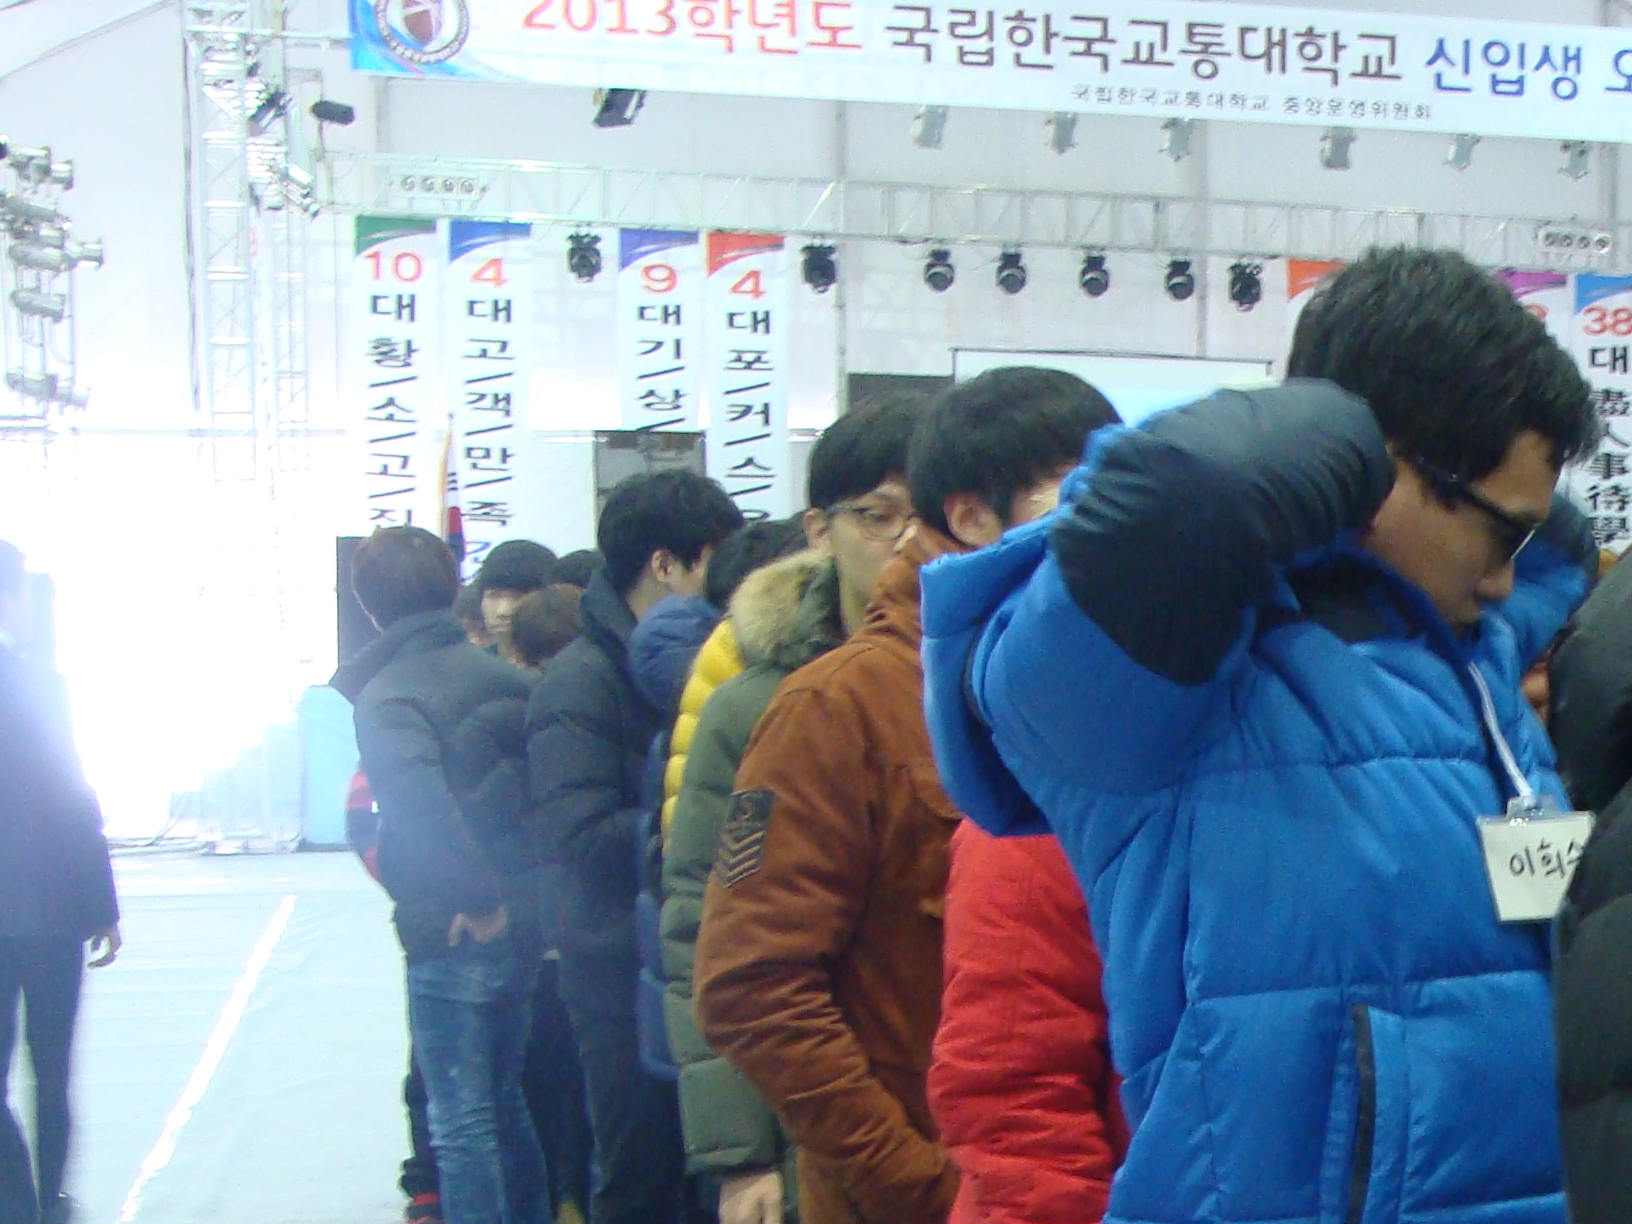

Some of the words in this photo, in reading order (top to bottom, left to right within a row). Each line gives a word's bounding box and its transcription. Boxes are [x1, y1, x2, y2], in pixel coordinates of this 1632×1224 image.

[521, 0, 863, 55] 2013학년도
[884, 4, 1404, 88] 국립한국교통대학교
[1424, 37, 1584, 101] 신입생
[1071, 83, 1270, 112] 국립한국교통대학교
[1282, 96, 1432, 121] 중앙운영위원회
